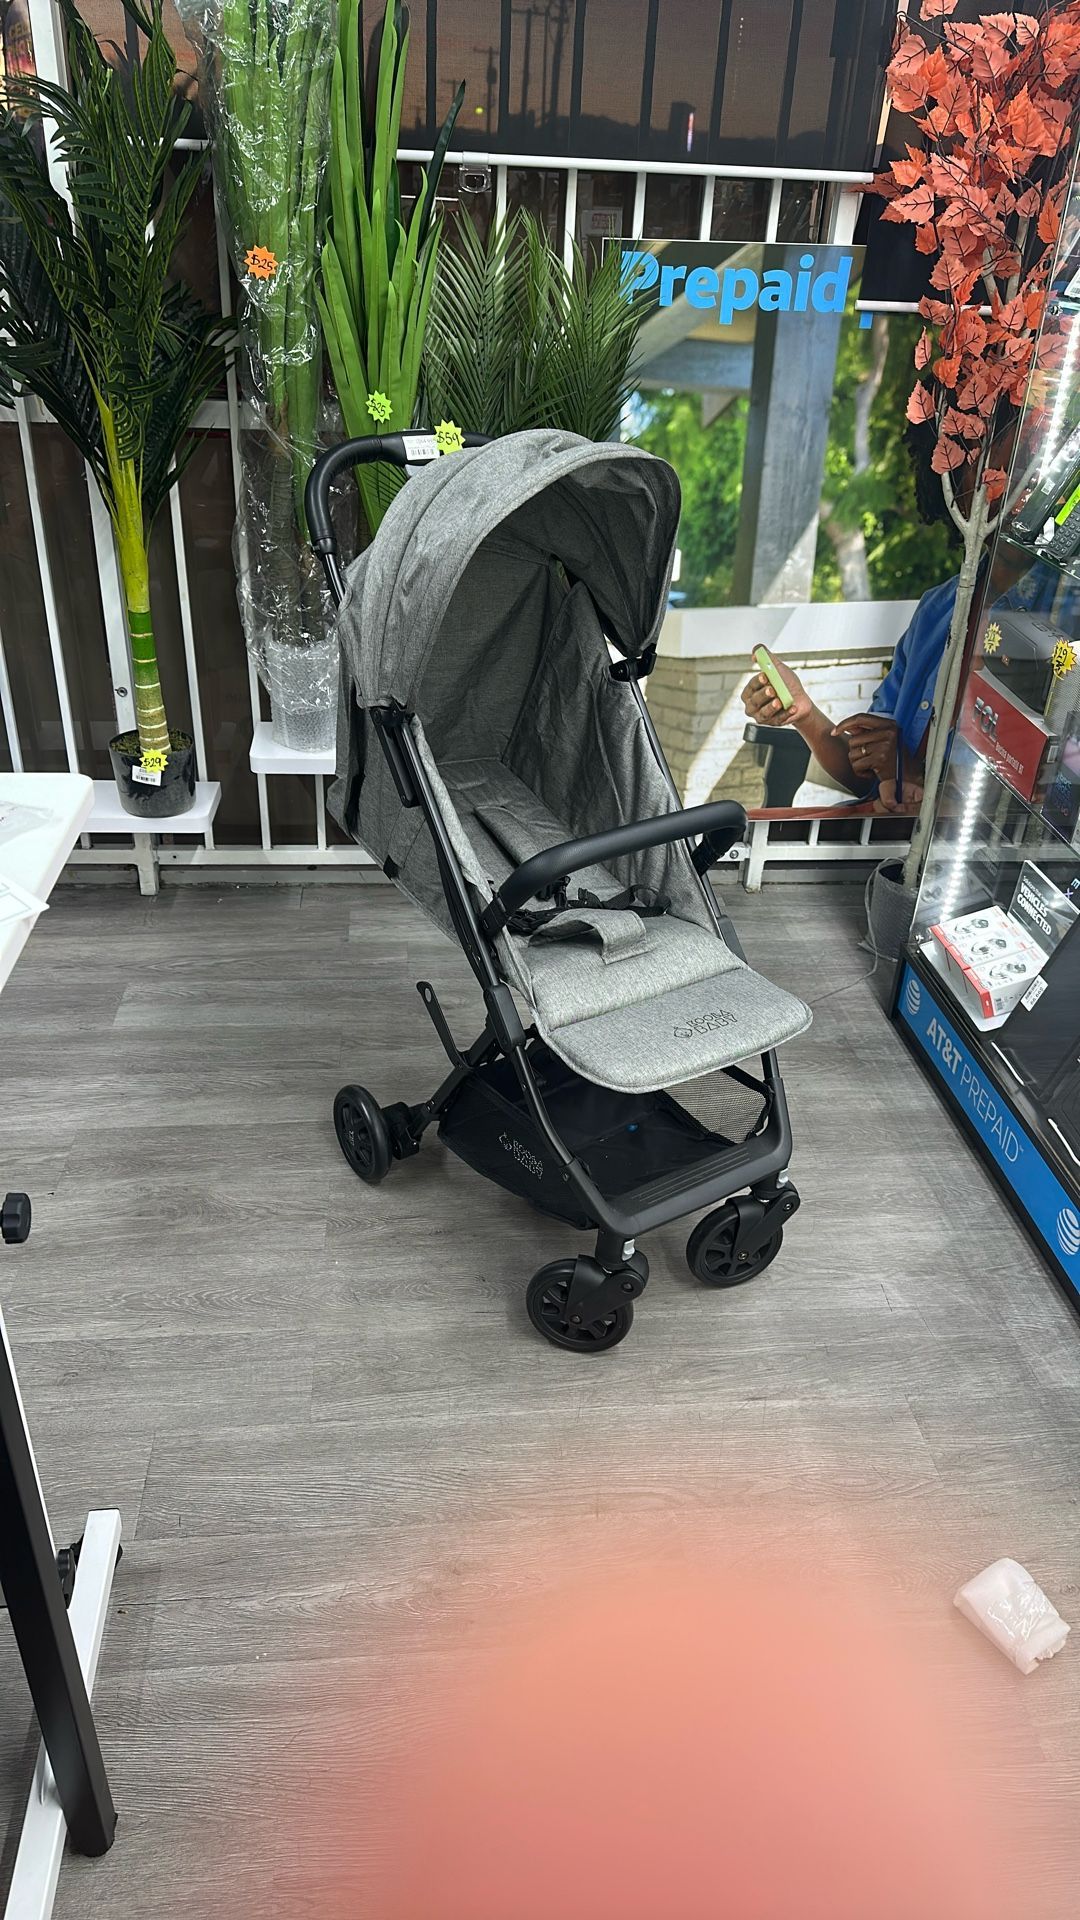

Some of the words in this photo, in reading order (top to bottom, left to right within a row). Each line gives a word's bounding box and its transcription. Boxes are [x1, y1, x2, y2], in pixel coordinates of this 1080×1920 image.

[249, 253, 274, 272] $25
[619, 250, 854, 326] Prepaid
[367, 398, 387, 418] $25
[436, 431, 461, 447] $59
[1016, 893, 1052, 936] CONNECTED
[1020, 882, 1048, 918] VEHICLES
[693, 1013, 738, 1035] BABY
[926, 1017, 963, 1076] AT&T
[959, 1063, 1020, 1163] PREPAID
